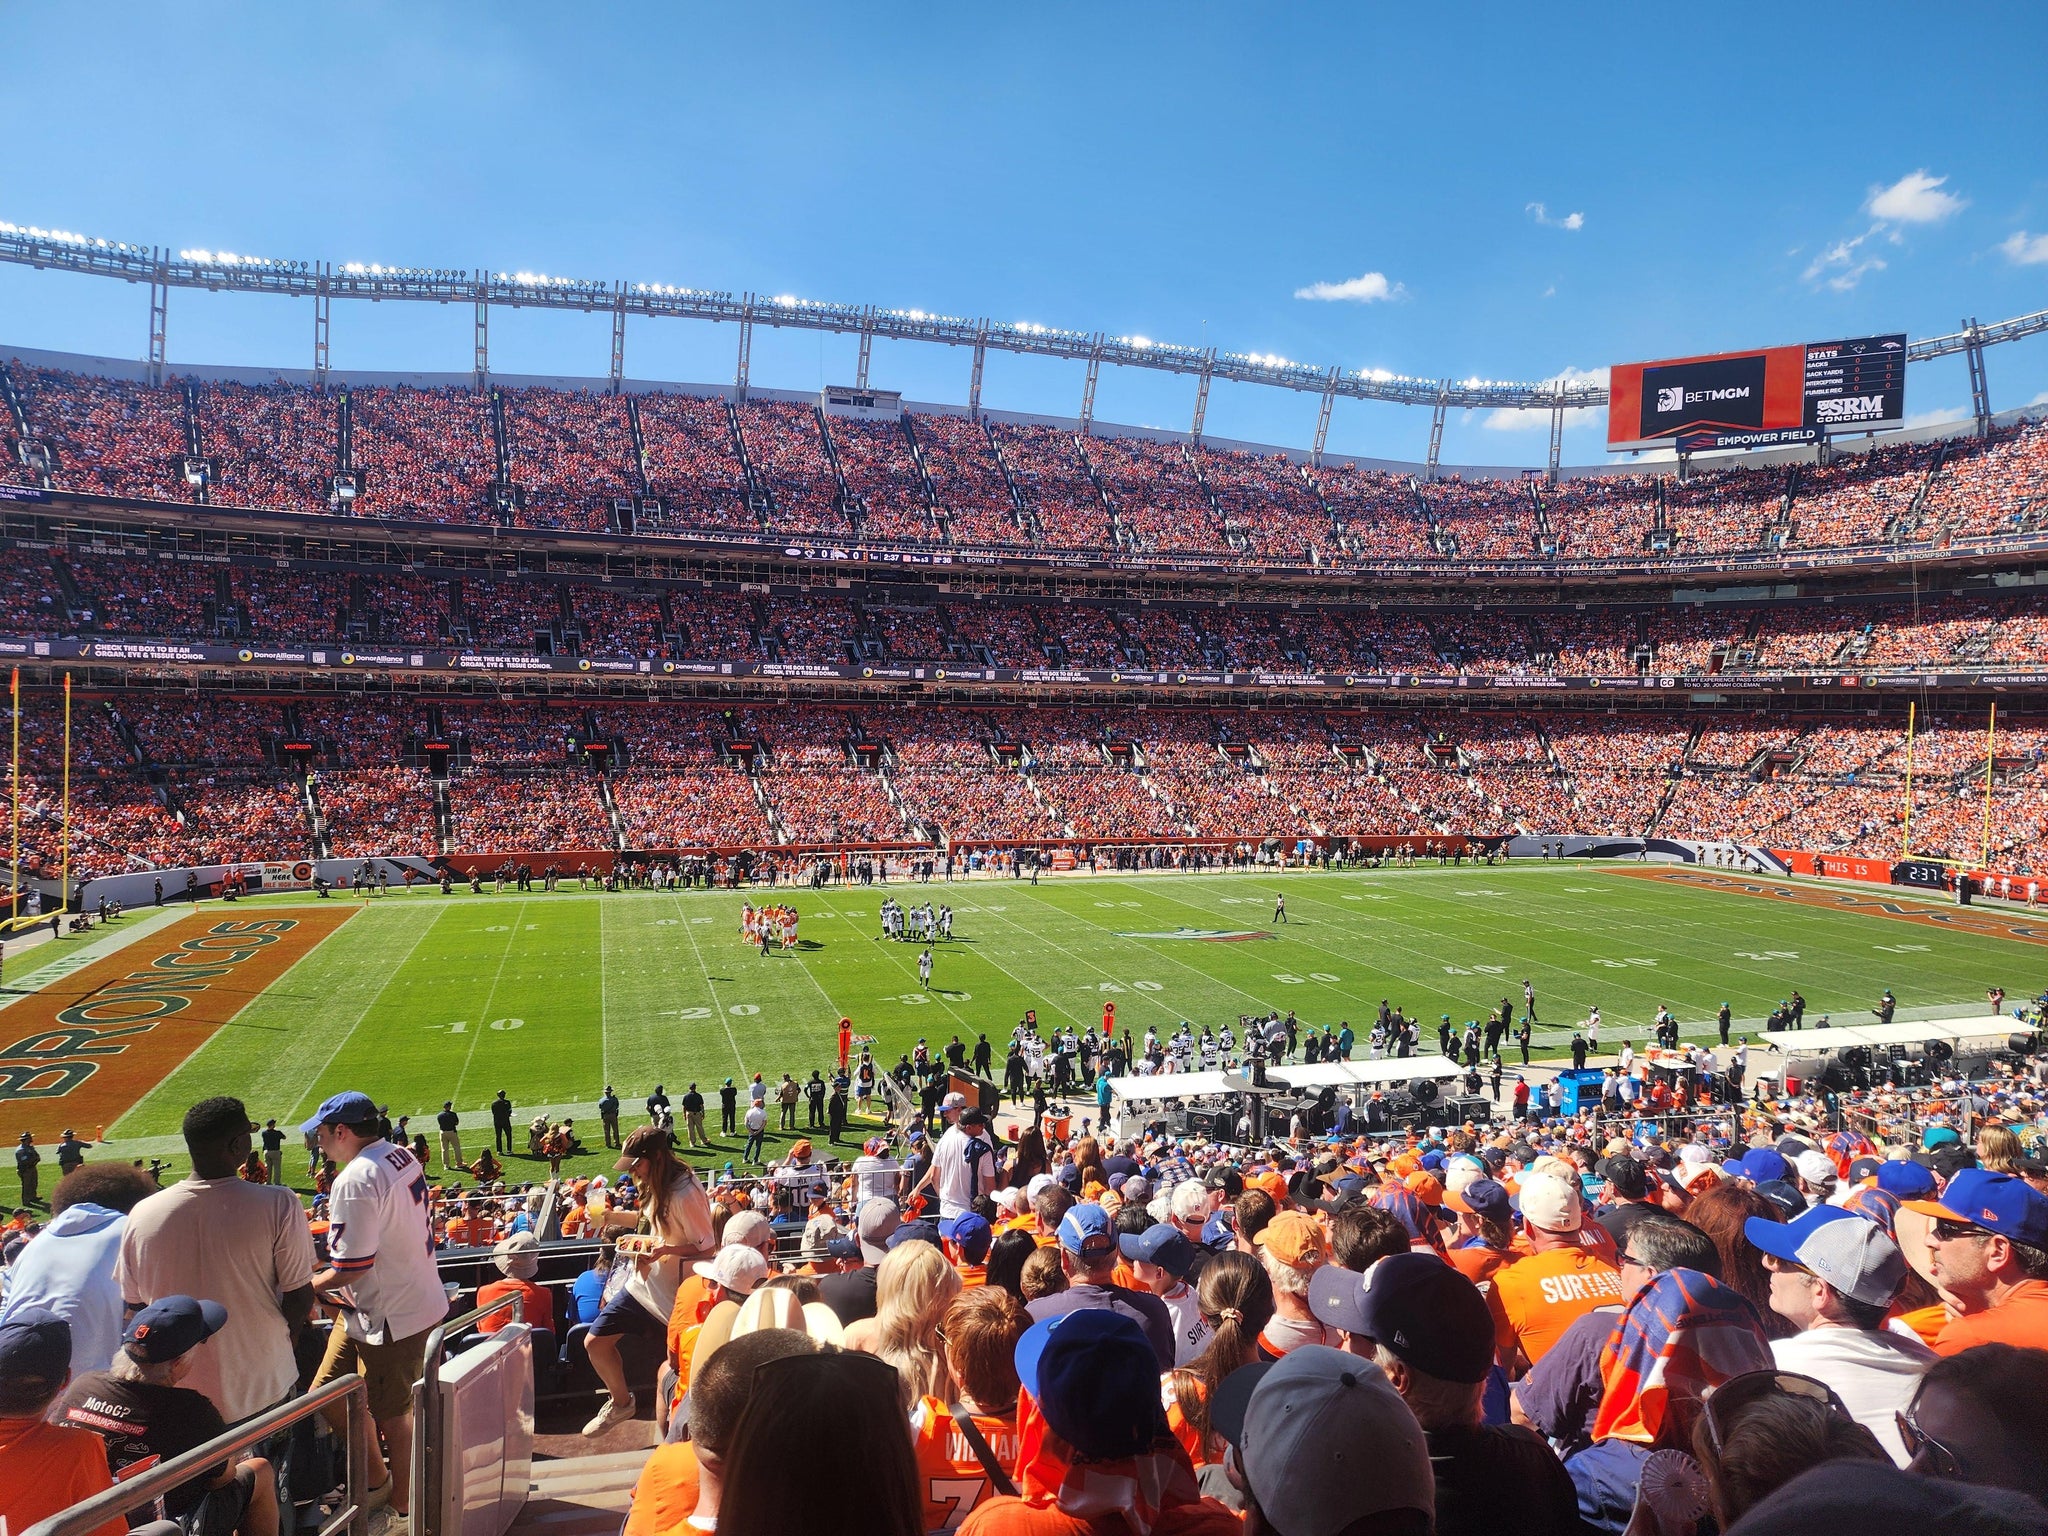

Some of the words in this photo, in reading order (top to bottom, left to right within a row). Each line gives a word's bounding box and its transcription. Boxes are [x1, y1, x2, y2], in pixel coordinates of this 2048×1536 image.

[1808, 350, 1837, 360] STATS
[1685, 386, 1750, 403] BETMGM
[1829, 395, 1884, 416] SRM
[1816, 412, 1883, 423] CONCRETE
[1717, 432, 1779, 447] EMPOWER
[1781, 429, 1816, 441] FIELD
[2007, 544, 2029, 552] SMITH
[204, 555, 231, 563] location
[852, 551, 859, 559] 0
[1910, 551, 1952, 560] THOMPSON
[1736, 563, 1780, 571] GRADISHAR
[123, 644, 138, 652] THE
[138, 645, 155, 653] BOX
[95, 650, 126, 658] ORGAN,
[176, 652, 206, 660] DONOR.
[254, 652, 305, 660] DonorAlliance
[355, 655, 404, 663] DonorAlliance
[1813, 678, 1832, 686] 2:37
[1824, 861, 1848, 873] THIS
[1855, 864, 1868, 875] IS
[1910, 867, 1937, 881] 2:37
[0, 919, 299, 1100] BRONCOS
[1028, 1011, 1037, 1023] 3
[1066, 1040, 1076, 1050] 91
[1206, 1050, 1217, 1059] 25
[331, 1222, 346, 1250] 7
[82, 1396, 131, 1418] MotoGP
[68, 1409, 87, 1421] WORLD
[86, 1412, 144, 1434] CHAMPIONSHIP
